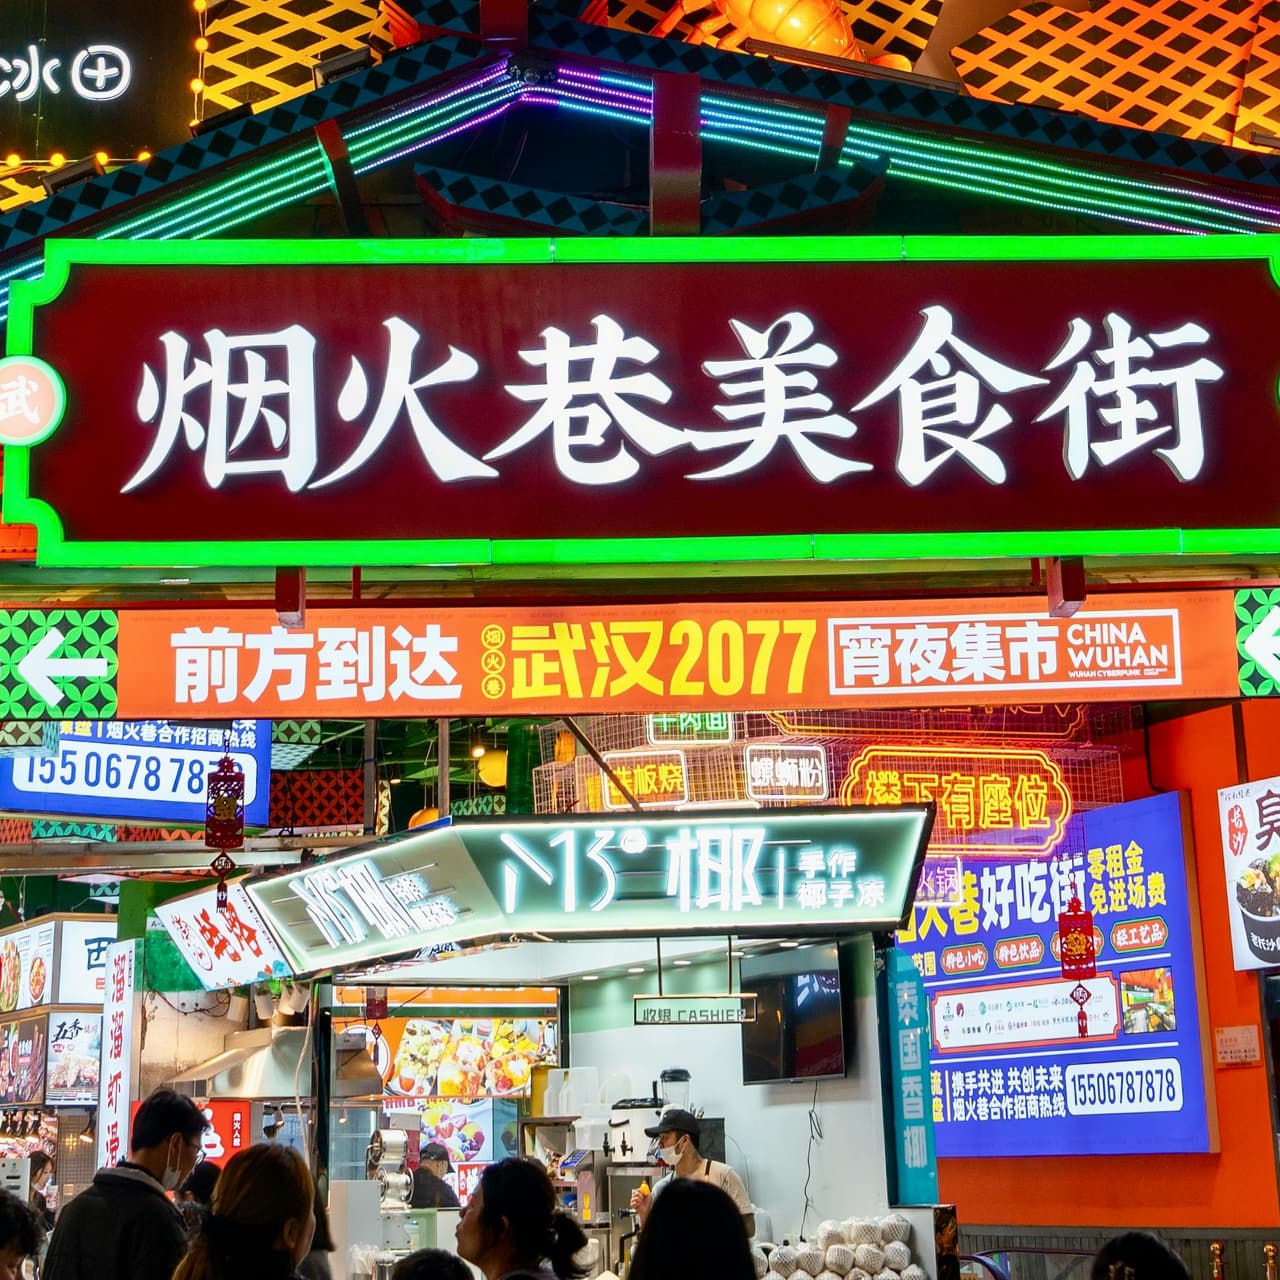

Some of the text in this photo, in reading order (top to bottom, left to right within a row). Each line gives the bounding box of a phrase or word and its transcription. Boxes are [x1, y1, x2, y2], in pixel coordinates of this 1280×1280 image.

[121, 306, 1223, 490] 烟火巷美食街
[840, 621, 1060, 684] 宵夜集市
[1067, 622, 1147, 645] CHINA
[170, 625, 460, 702] 前方到达
[511, 620, 816, 699] 武汉2077
[1067, 644, 1169, 669] WUHAN
[799, 850, 857, 878] 手作
[1087, 840, 1145, 881] 零租金
[1088, 872, 1167, 915] 免进场费
[642, 1007, 747, 1023] 收银 CASHIER
[952, 1064, 1065, 1097] 携手共进 共创未来
[1071, 1068, 1177, 1107] 15506787878
[953, 1094, 1067, 1123] 烟火巷合作招商热线
